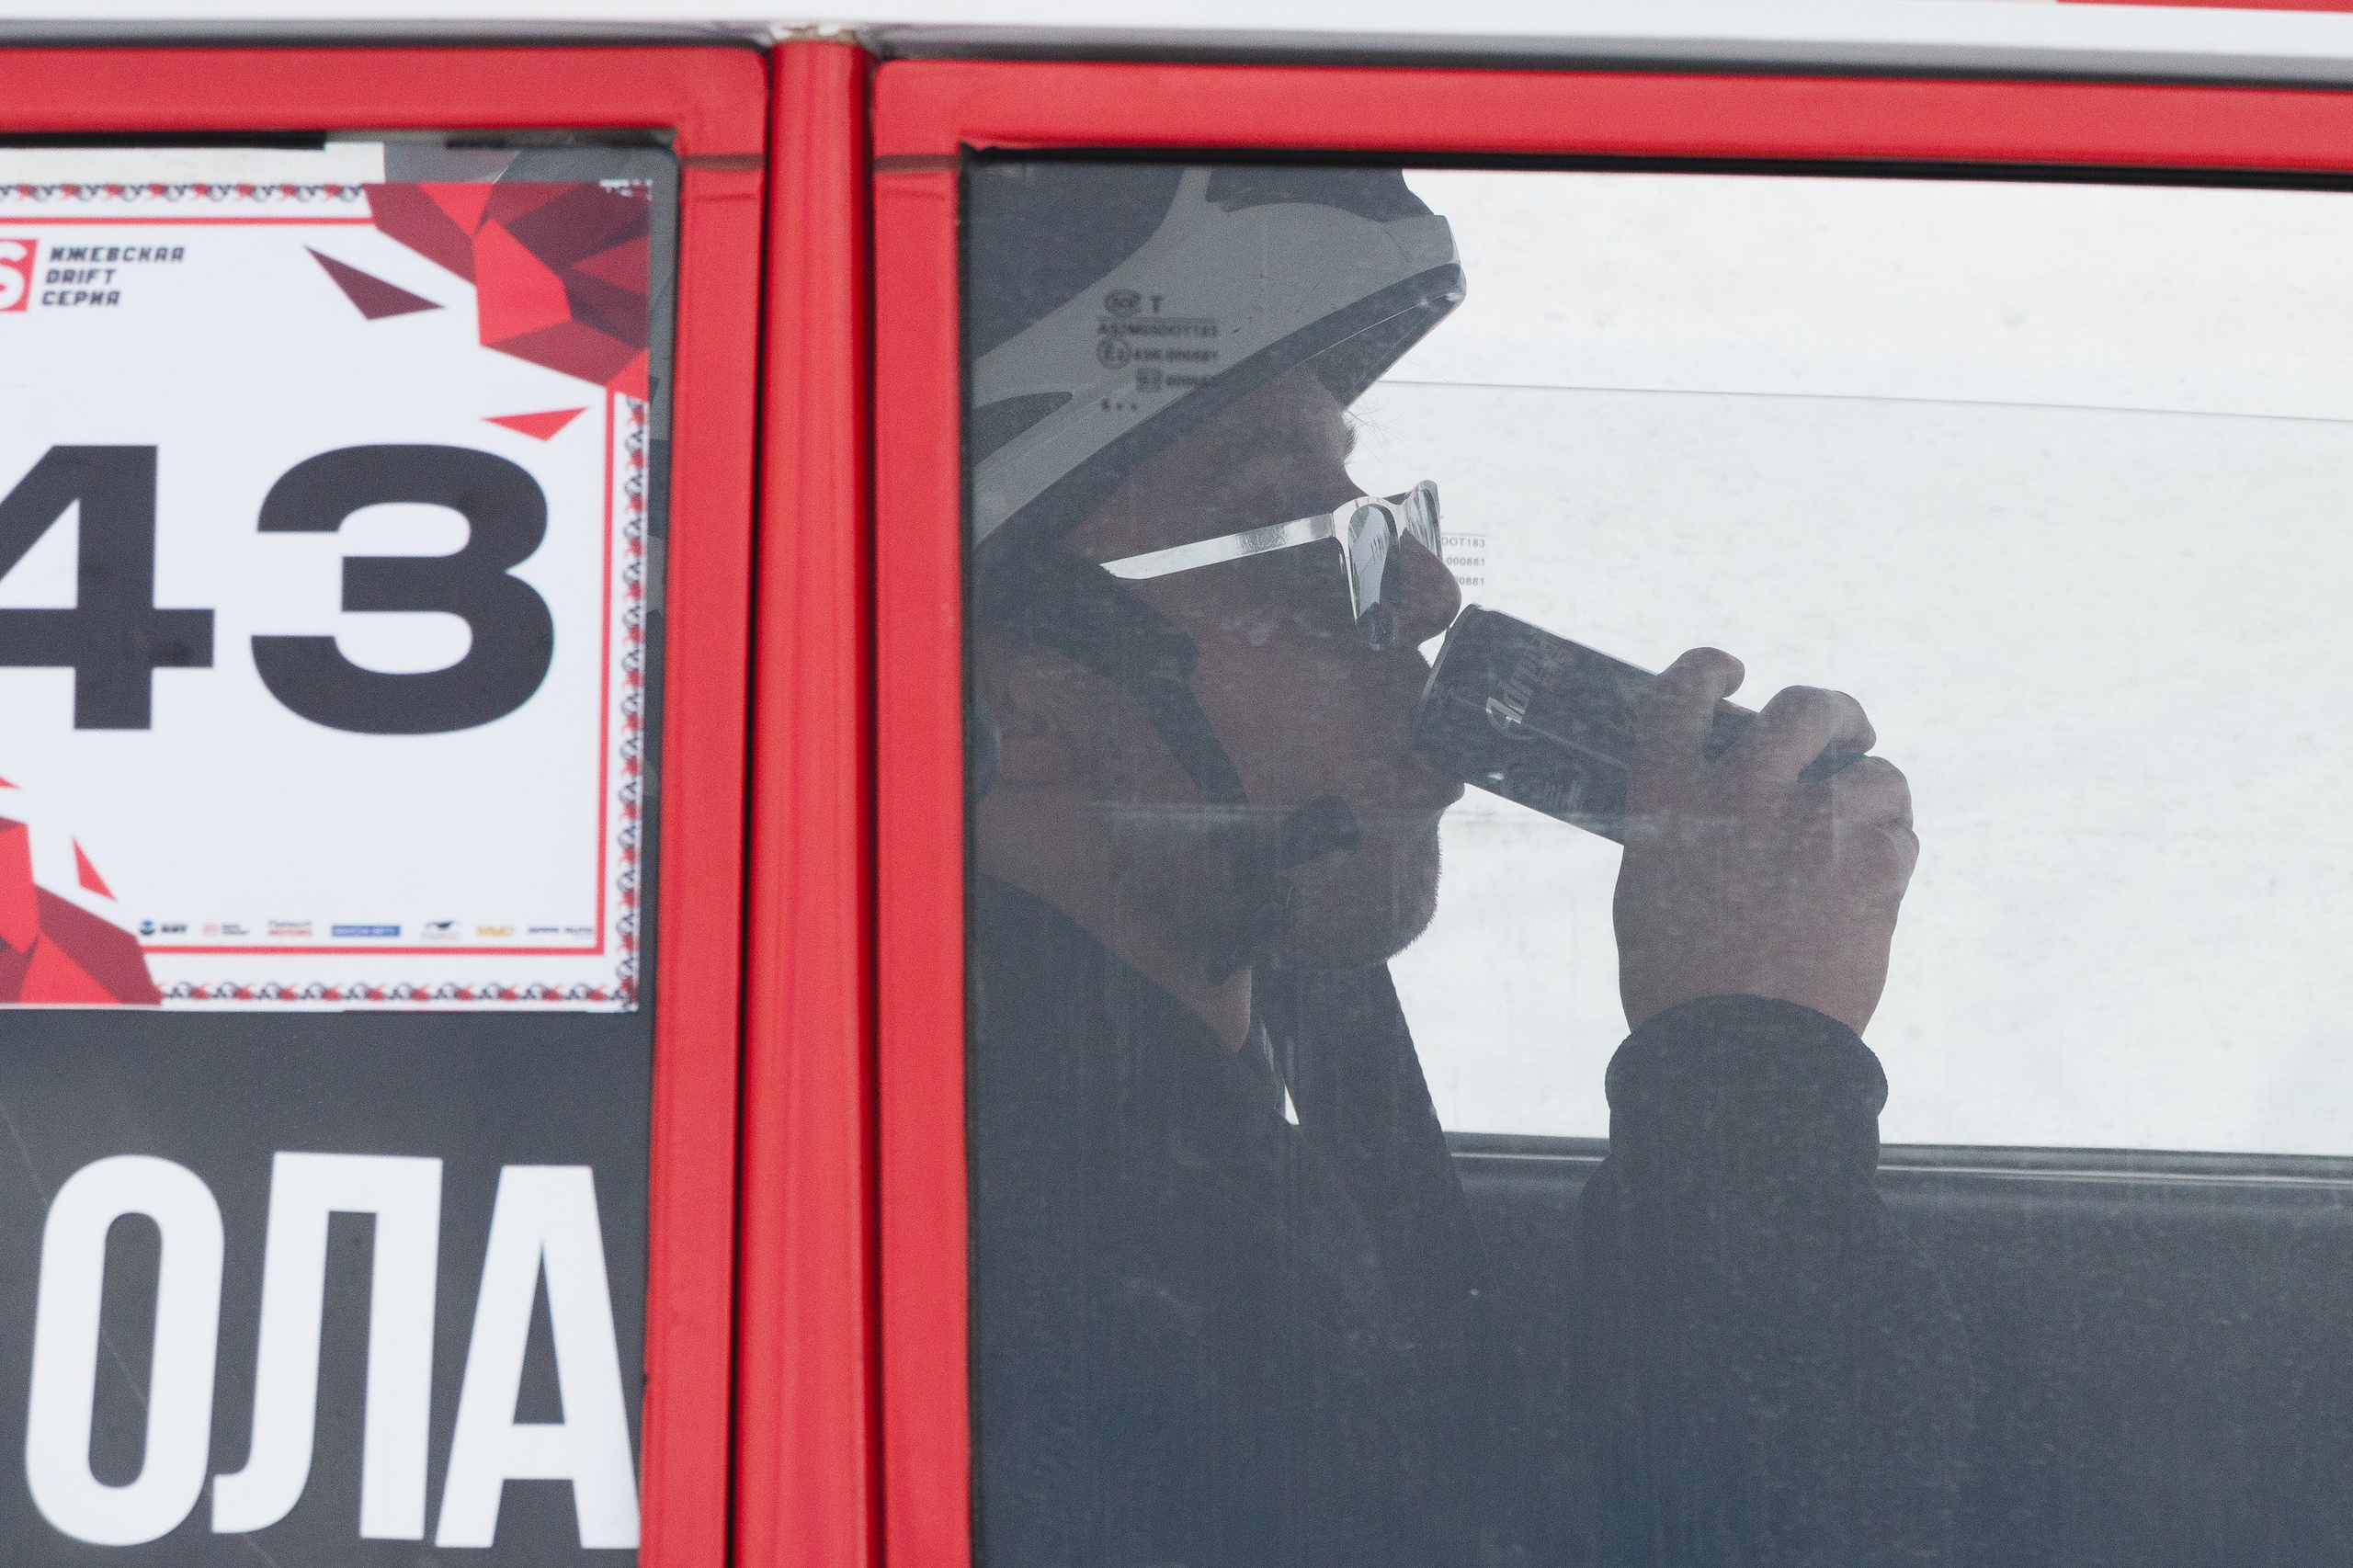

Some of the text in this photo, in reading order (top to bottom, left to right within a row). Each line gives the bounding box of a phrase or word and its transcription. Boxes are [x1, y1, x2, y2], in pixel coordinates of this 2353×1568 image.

[41, 290, 120, 306] СЕРИЯ
[45, 268, 117, 284] DRIFT
[0, 444, 555, 736] 43
[25, 1152, 642, 1548] ОЛА
